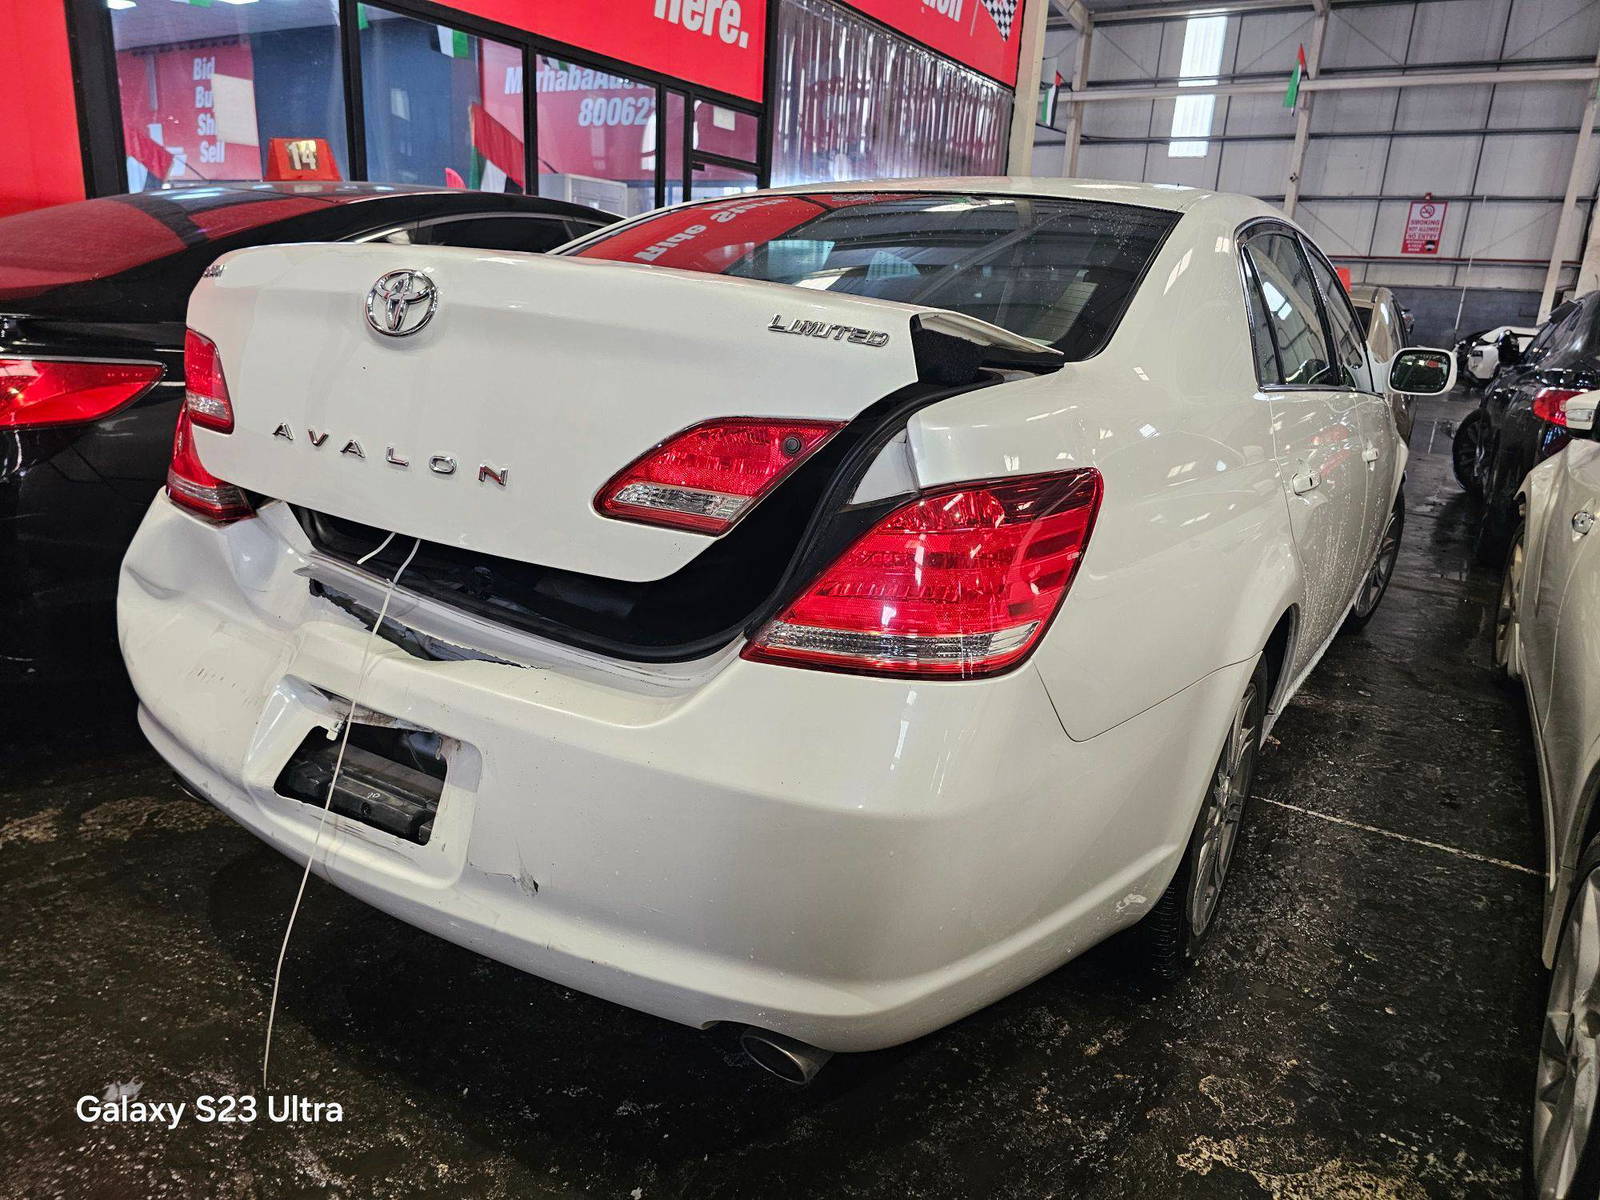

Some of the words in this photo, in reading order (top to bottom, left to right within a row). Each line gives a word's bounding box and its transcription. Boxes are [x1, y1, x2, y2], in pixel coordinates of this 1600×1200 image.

[193, 56, 215, 80] Bid
[195, 86, 214, 109] Bu
[578, 96, 656, 127] 80062
[200, 141, 225, 163] Sell
[285, 140, 317, 170] 14
[768, 314, 889, 347] LIMITED
[272, 422, 509, 486] AVALON
